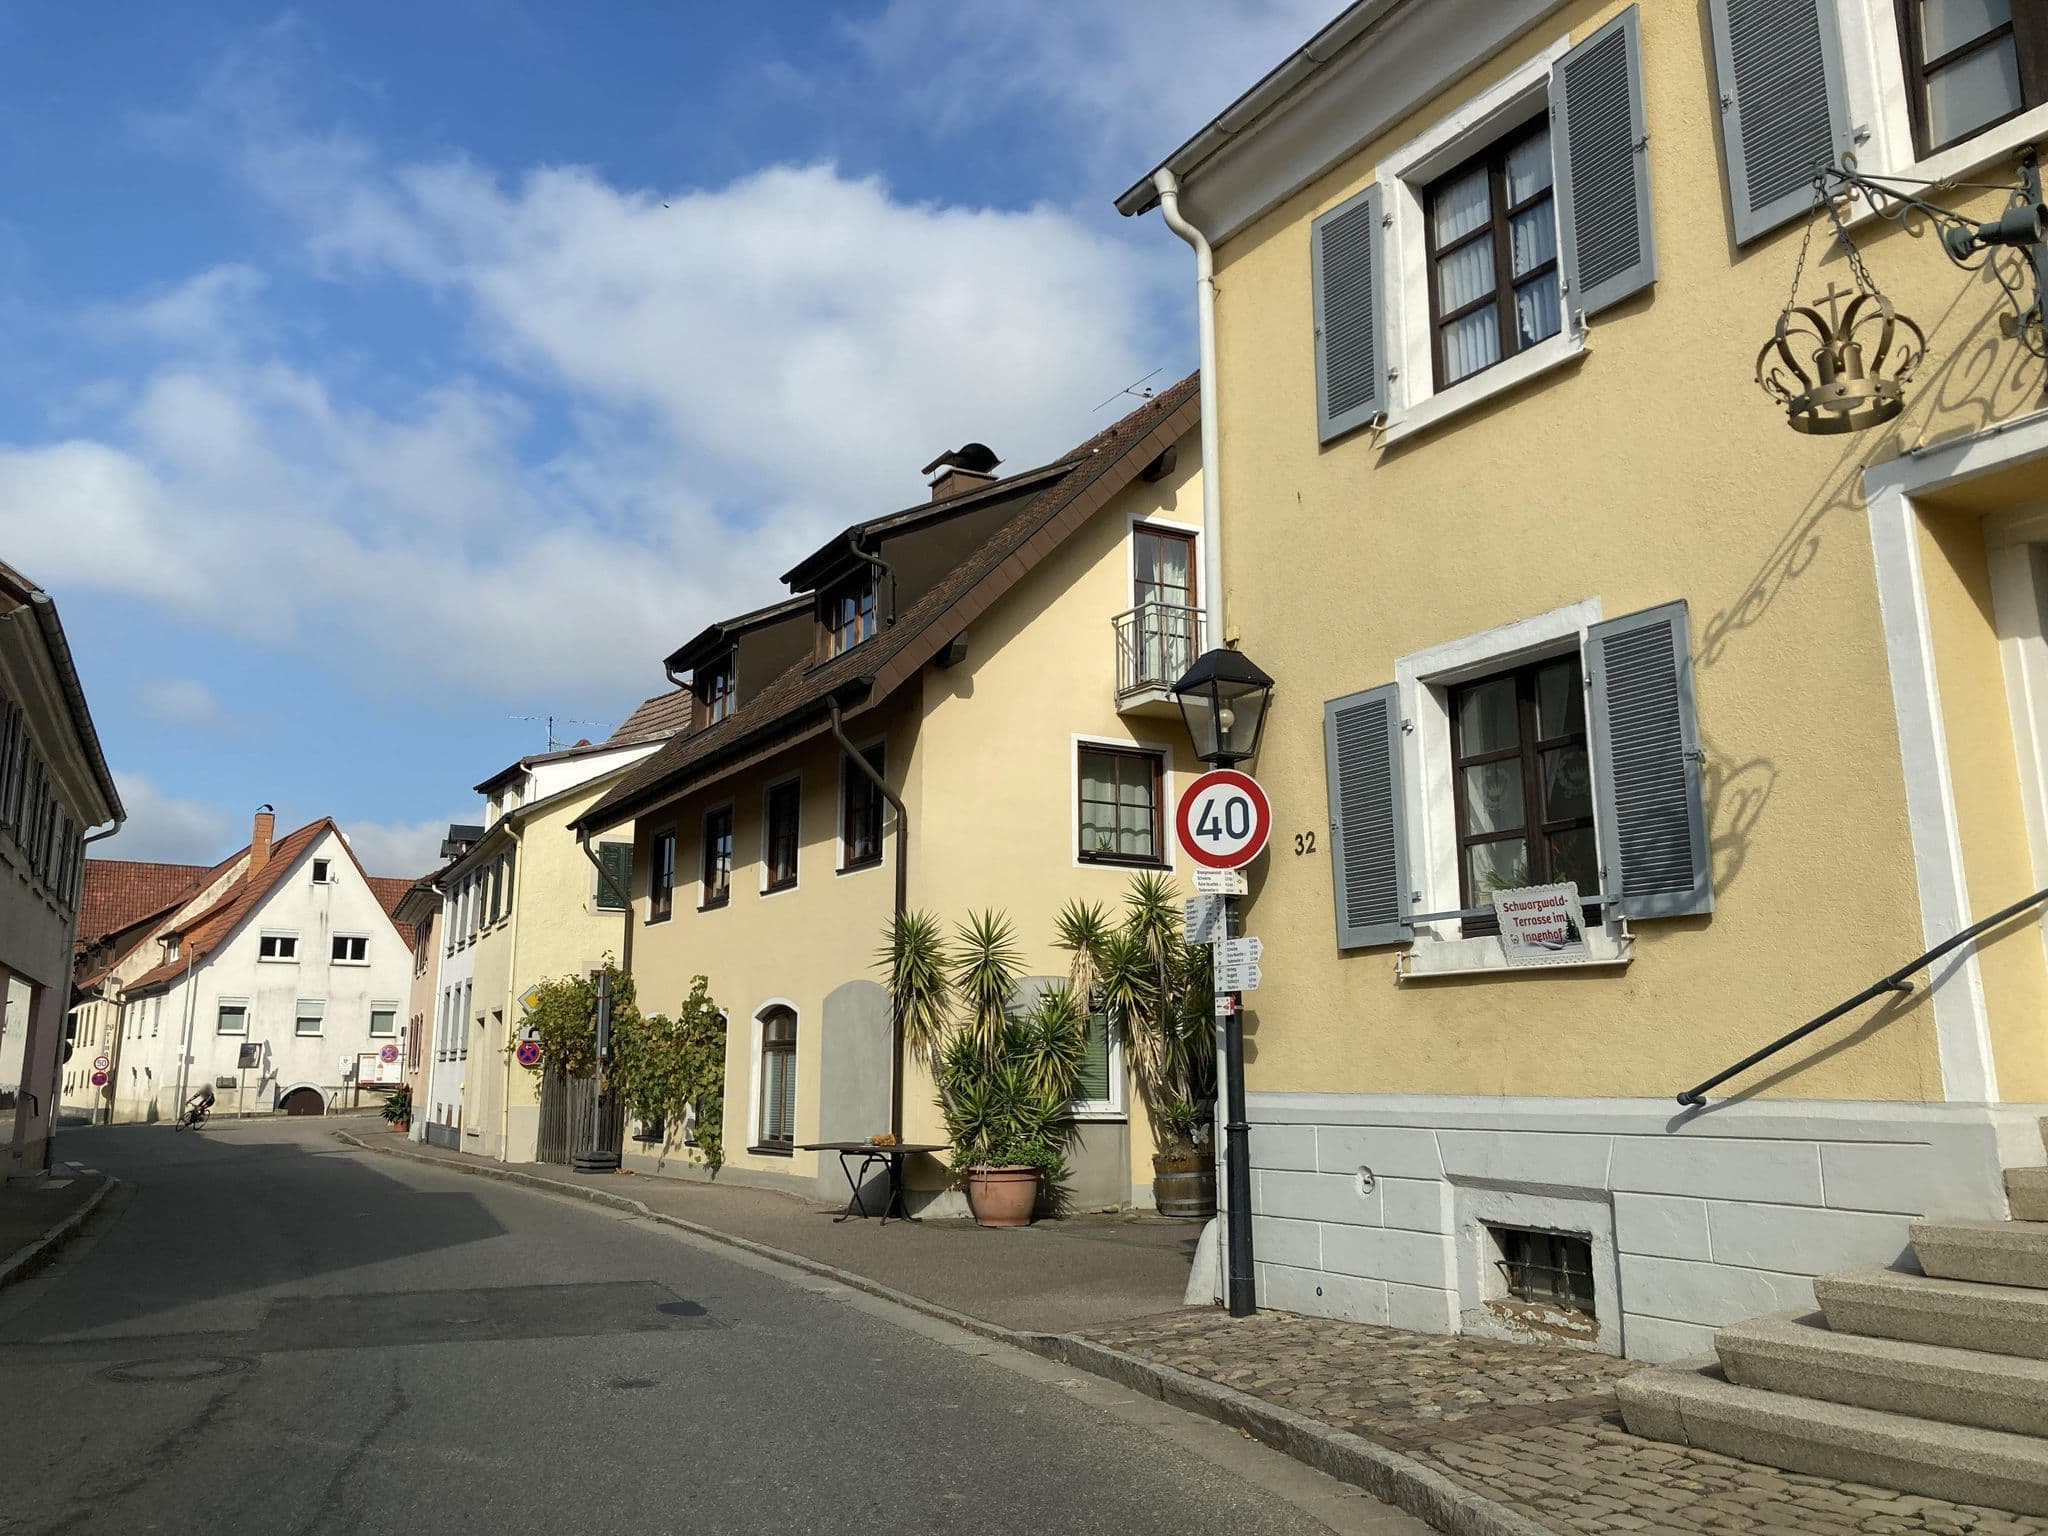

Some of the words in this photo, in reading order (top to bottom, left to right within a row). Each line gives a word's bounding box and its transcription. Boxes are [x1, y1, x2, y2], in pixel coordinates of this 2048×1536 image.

[1196, 796, 1250, 841] 40
[1294, 830, 1317, 856] 32
[1503, 896, 1568, 912] Schwarzwald-
[1512, 915, 1552, 927] Terrasse
[1553, 912, 1565, 923] im
